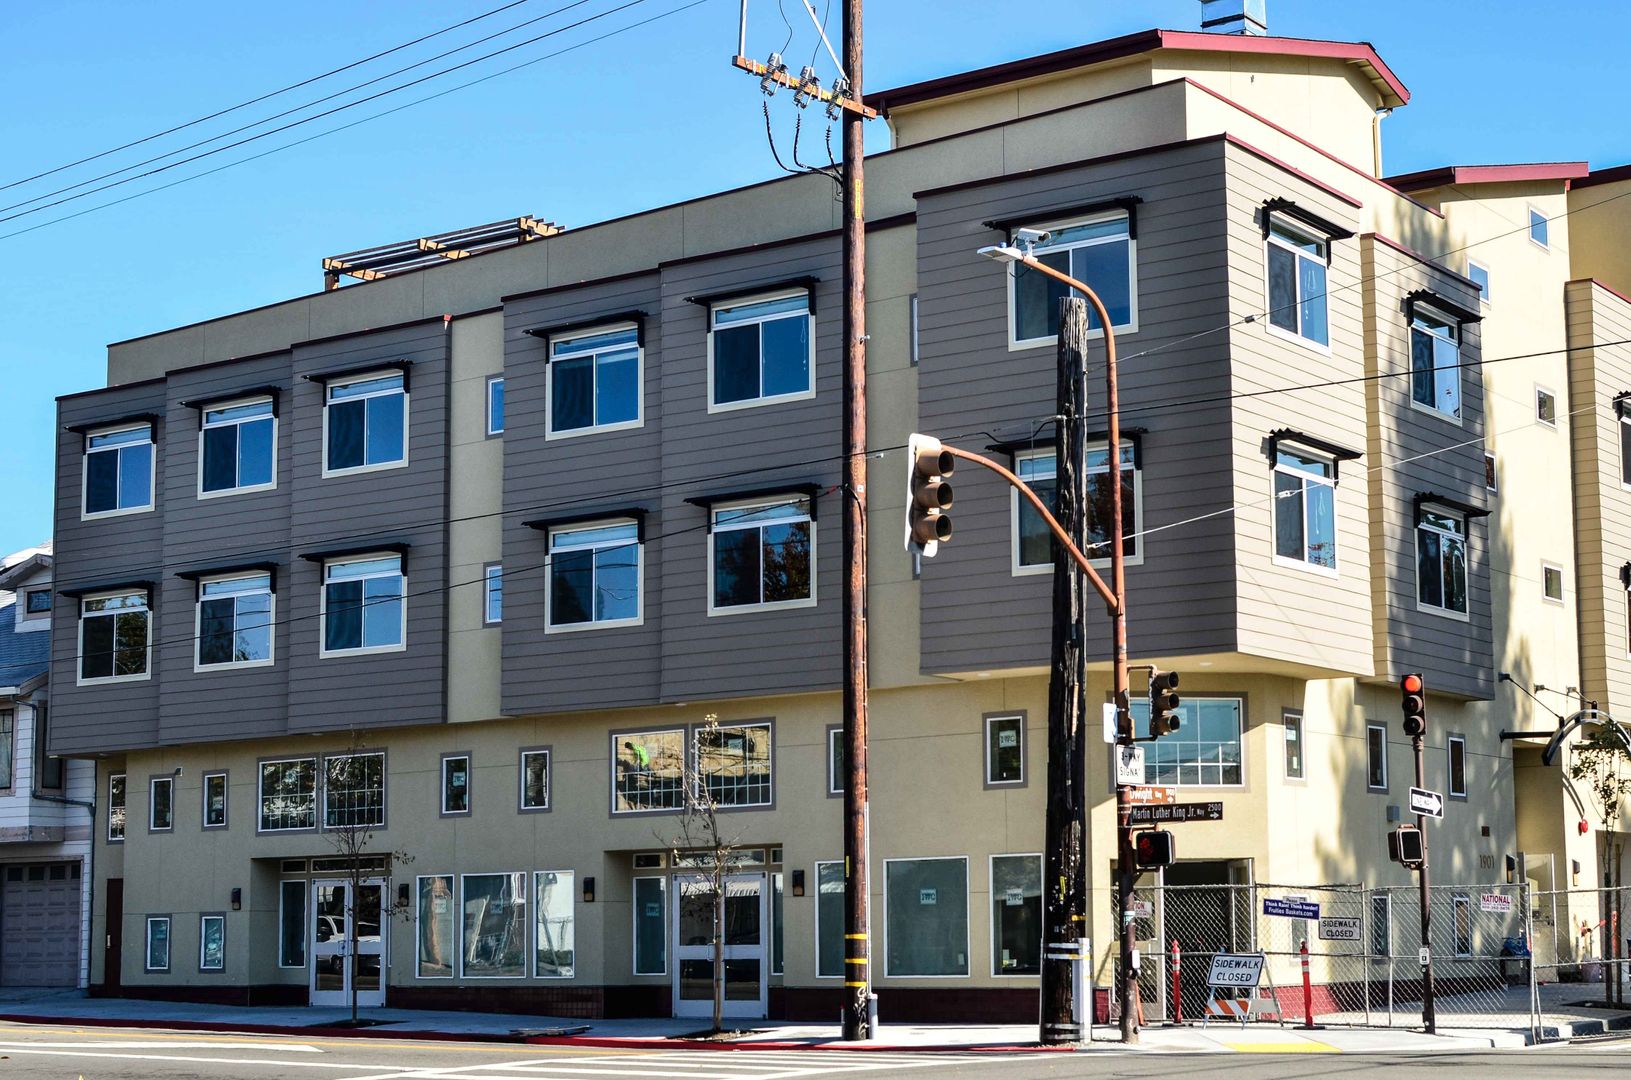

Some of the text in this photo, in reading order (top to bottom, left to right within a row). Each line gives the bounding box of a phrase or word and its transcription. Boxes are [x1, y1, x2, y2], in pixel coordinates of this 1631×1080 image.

[1120, 766, 1141, 777] SIGNA
[1132, 807, 1150, 819] Martin
[1152, 807, 1170, 819] Luther
[1172, 806, 1186, 820] King
[1187, 805, 1196, 817] Jr.
[1207, 803, 1222, 812] 2500
[1479, 855, 1495, 869] 1901
[1482, 895, 1510, 904] NATIONAL
[1322, 920, 1357, 928] SIDEWALK
[1325, 929, 1354, 938] CLOSED
[1214, 959, 1260, 969] SIDEWALK
[1216, 972, 1252, 982] CLOSED
